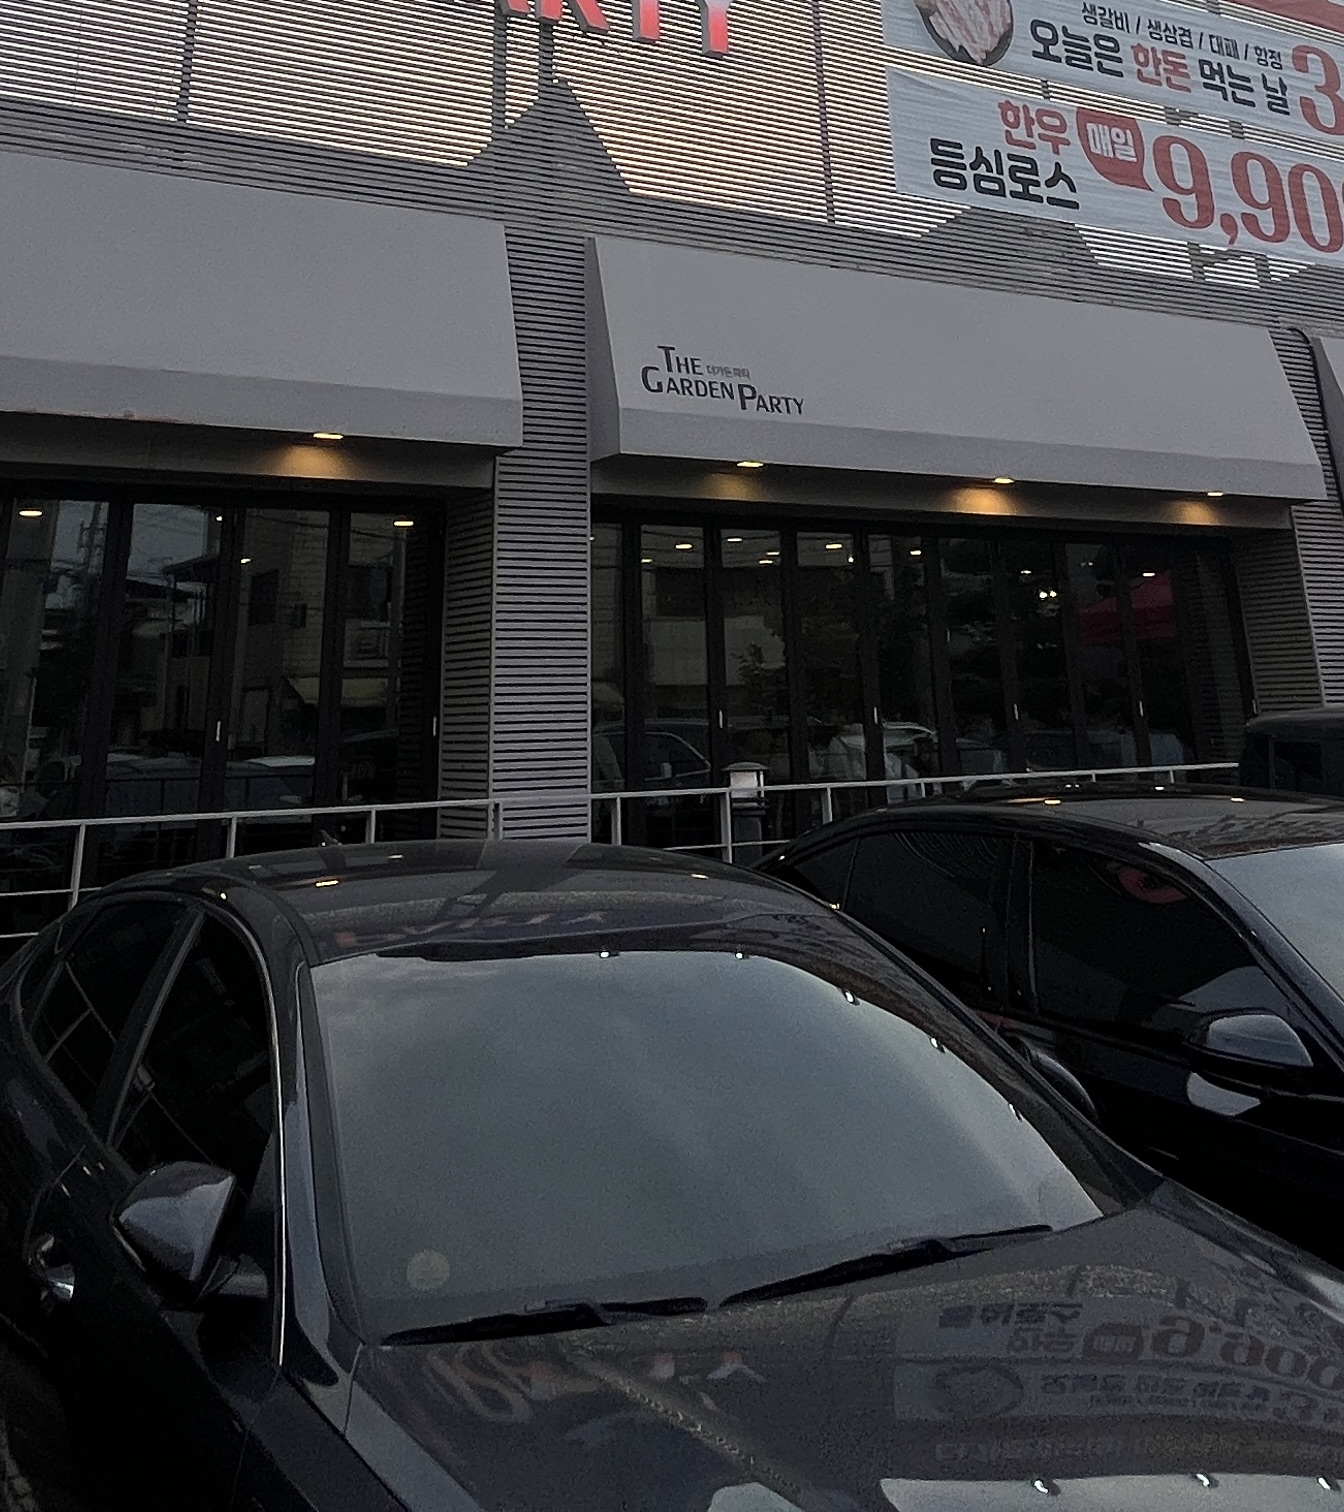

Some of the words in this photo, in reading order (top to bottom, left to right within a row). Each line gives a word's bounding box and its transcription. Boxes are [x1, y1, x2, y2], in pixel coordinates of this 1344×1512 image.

[1082, 1, 1130, 34] 생갈비
[1147, 18, 1193, 49] 생삼겹
[1208, 34, 1241, 60] 대패
[1254, 44, 1284, 70] 항정
[1030, 19, 1124, 78] 오늘은
[1130, 42, 1193, 93] 한돈
[1199, 58, 1256, 108] 먹는
[1261, 73, 1291, 116] 날
[998, 100, 1071, 155] 한우
[1086, 122, 1138, 163] 매일
[930, 138, 1080, 210] 등심로스
[657, 345, 704, 376] THE
[641, 366, 735, 401] GARDEN
[737, 383, 804, 415] PARTY
